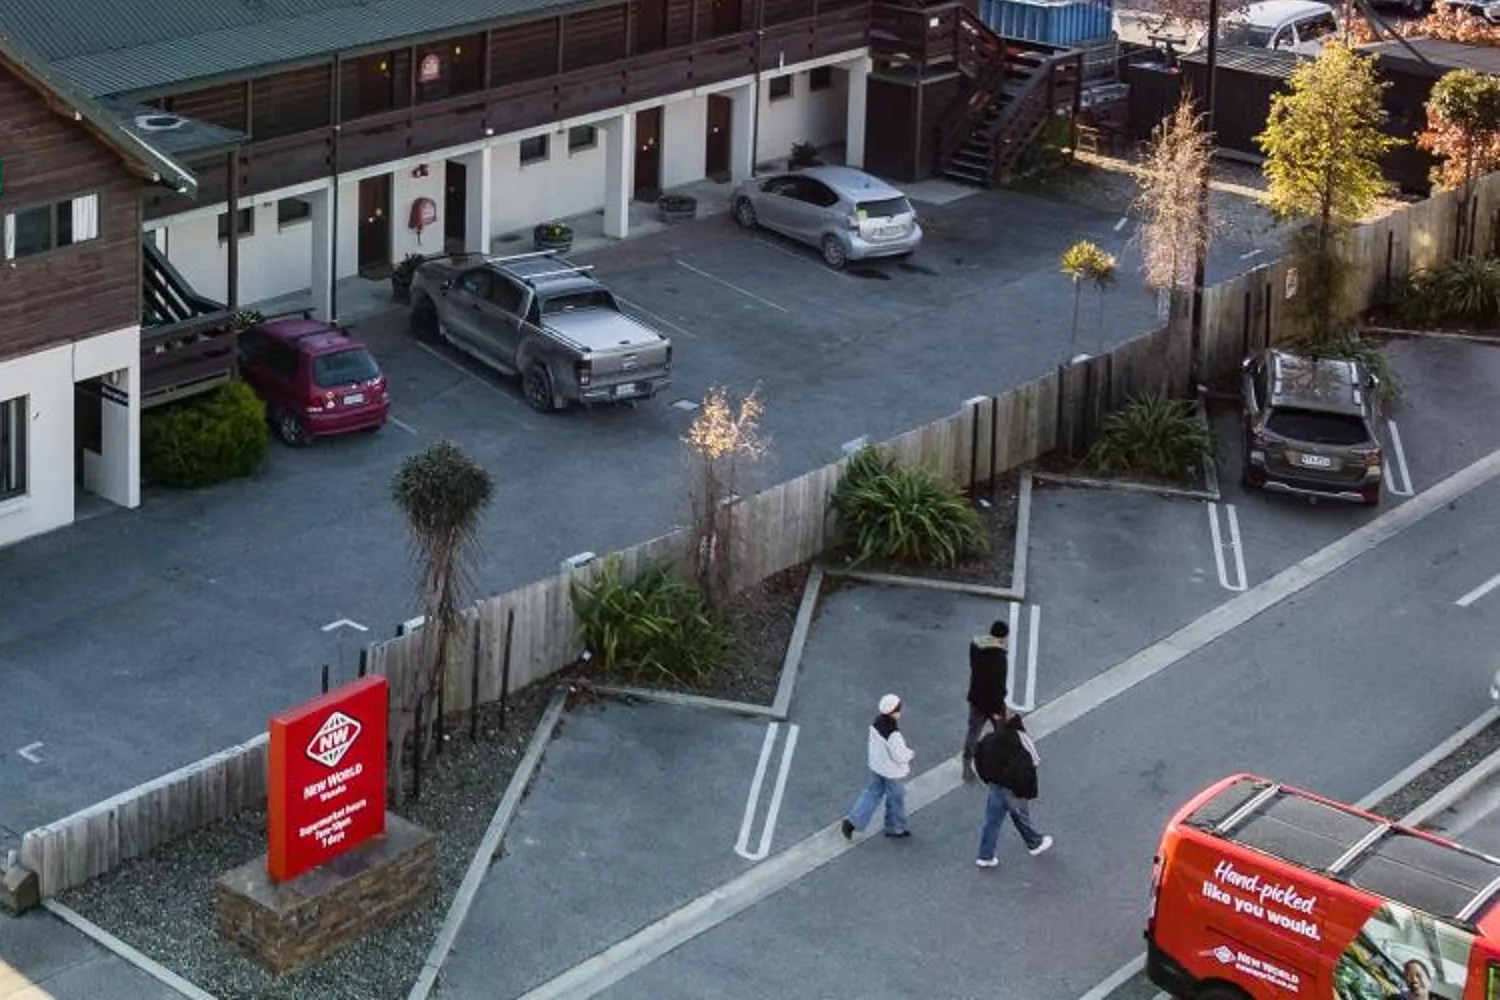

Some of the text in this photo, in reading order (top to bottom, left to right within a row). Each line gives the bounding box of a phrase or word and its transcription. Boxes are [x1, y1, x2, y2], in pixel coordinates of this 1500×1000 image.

[319, 725, 349, 753] NW
[303, 763, 363, 800] NEW WORLD
[1214, 860, 1317, 915] Hand-picked
[1202, 880, 1321, 941] like you would.
[1237, 951, 1261, 968] NEW
[1262, 961, 1299, 984] WORLD
